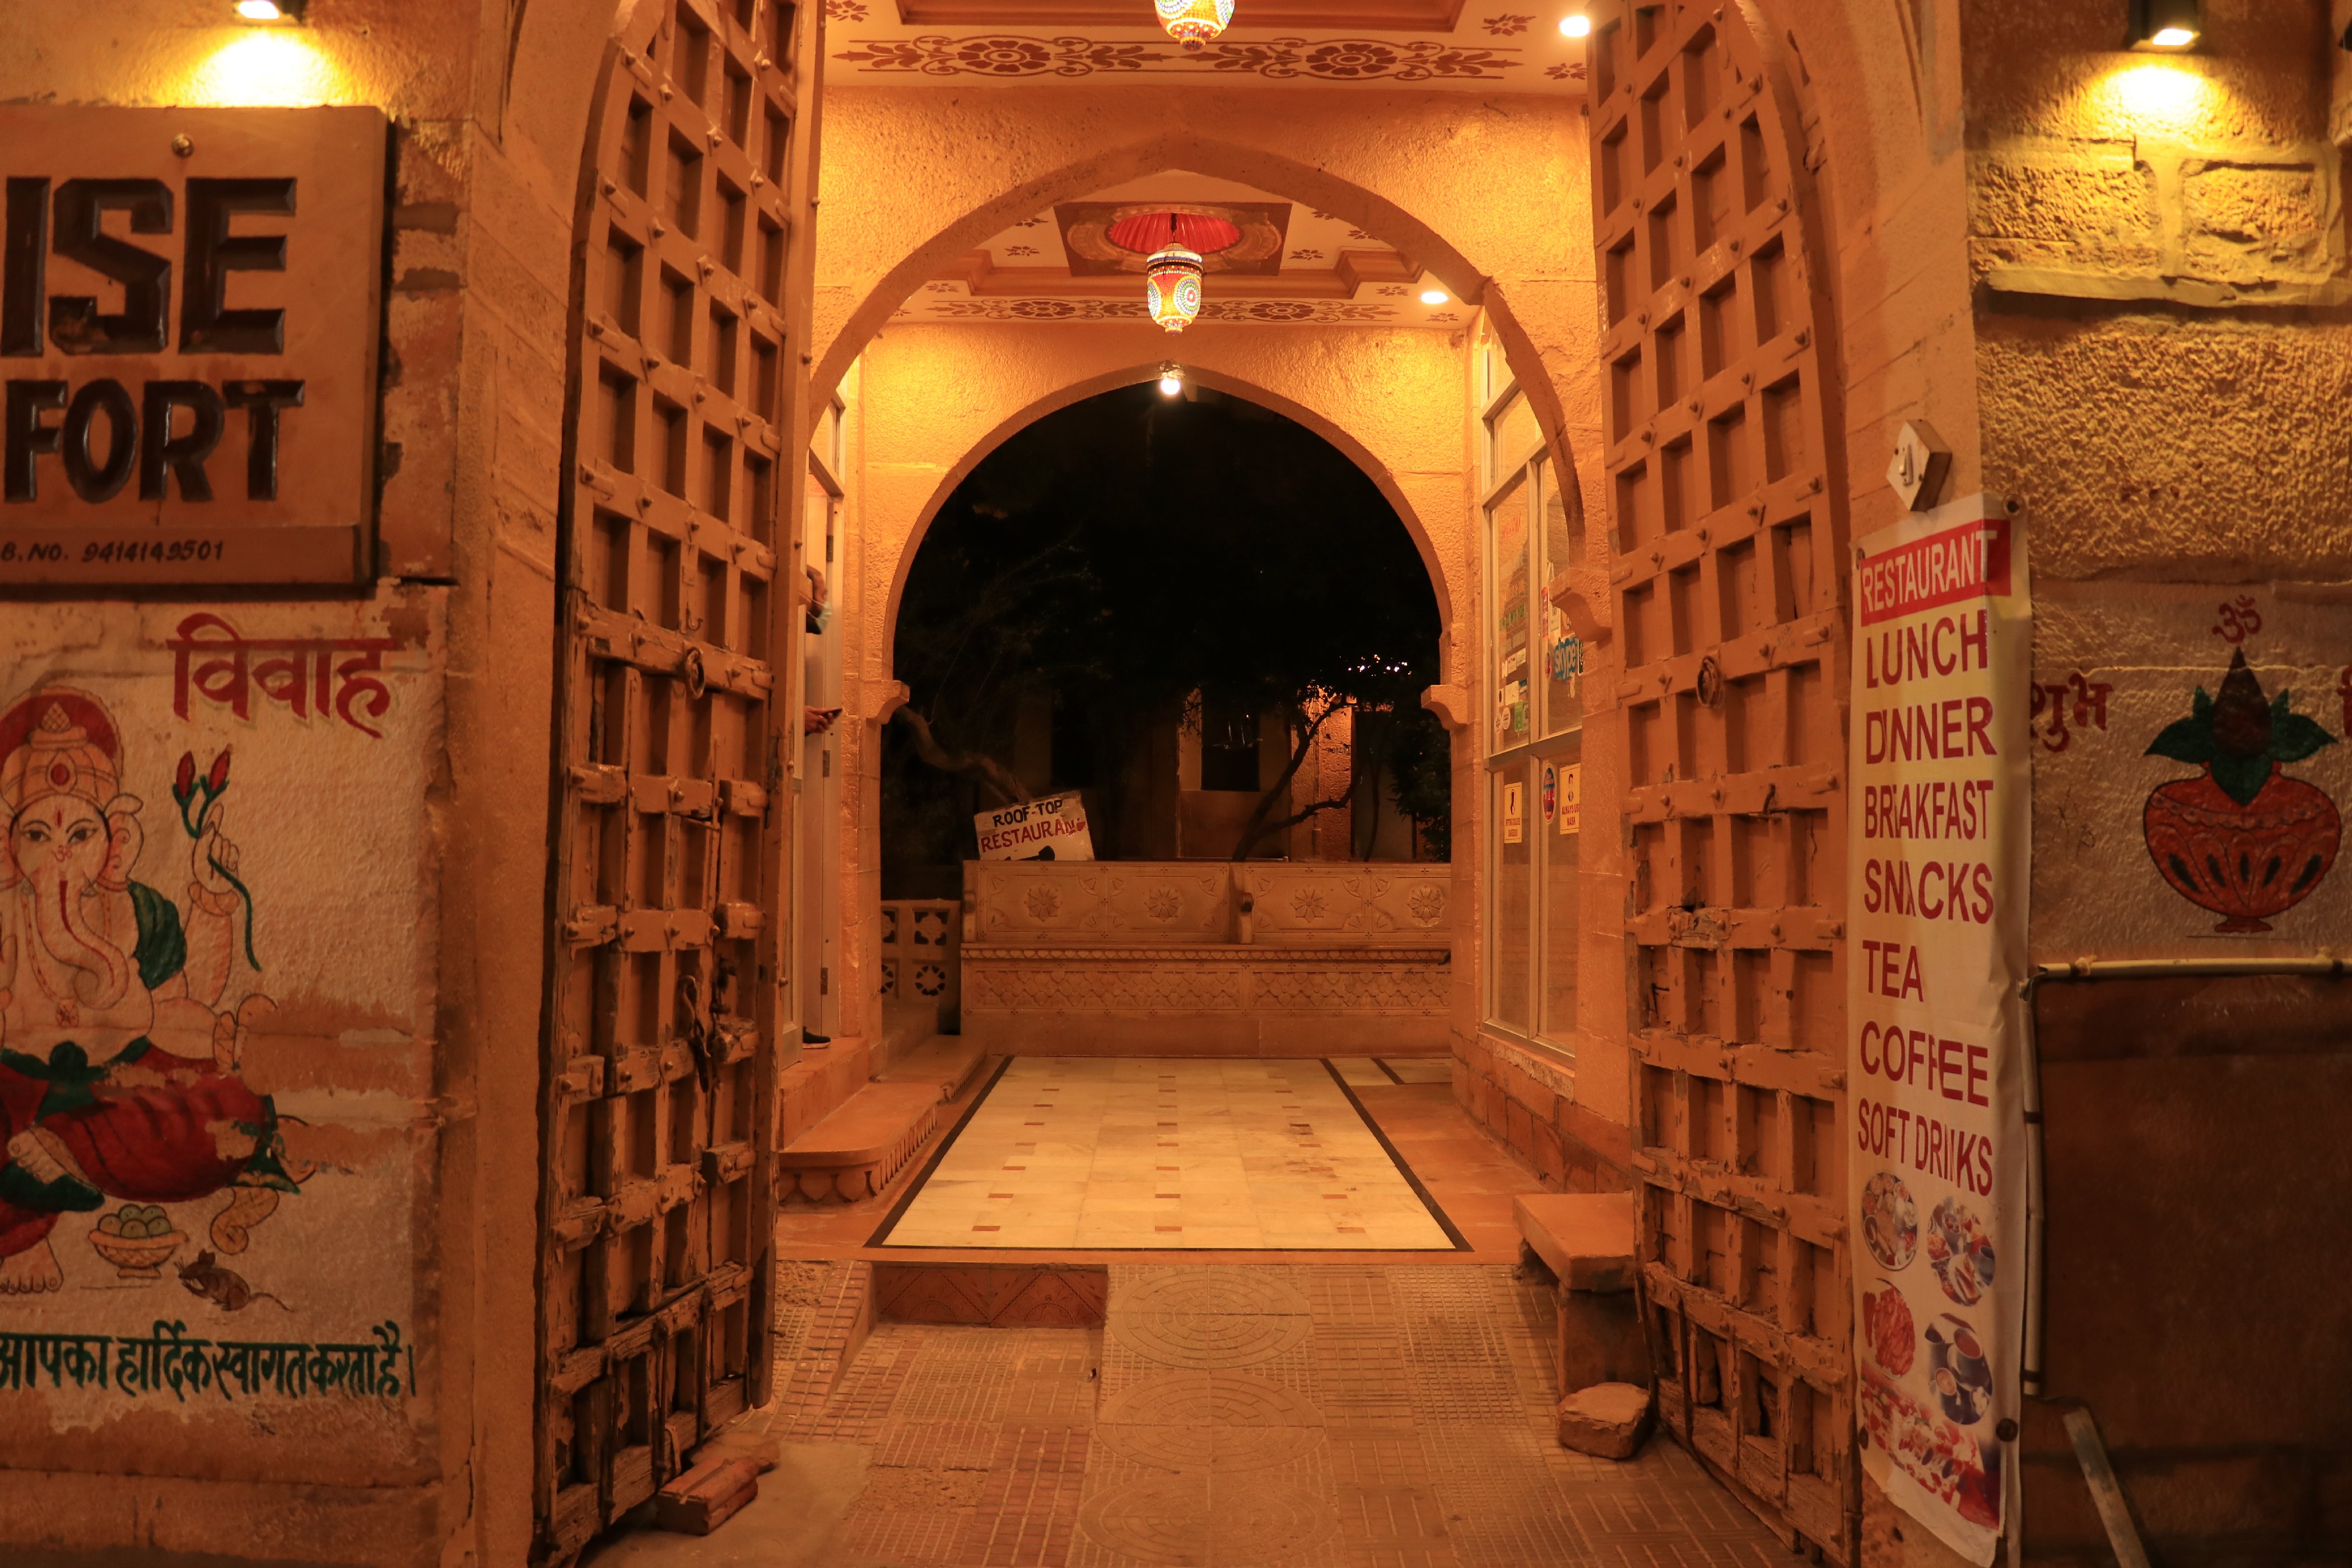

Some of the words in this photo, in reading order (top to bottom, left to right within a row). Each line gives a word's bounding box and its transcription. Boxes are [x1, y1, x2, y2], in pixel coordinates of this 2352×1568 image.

[0, 176, 296, 357] ISE
[4, 378, 305, 504] FORT
[1861, 530, 1997, 613] RESTAURANT
[166, 612, 395, 739] विवाह
[1554, 641, 1576, 679] skype
[1866, 609, 1988, 689] LUNCH
[1866, 696, 1997, 765] DINNER
[1562, 805, 1574, 815] ALWAYS
[1567, 816, 1576, 826] MASK
[1864, 858, 1994, 925] SNACKS
[1862, 939, 1924, 1002] TEA
[1860, 1021, 1989, 1108] COFFEE
[1858, 1098, 1910, 1164] SOFT
[0, 1332, 114, 1390] आपका
[116, 1319, 213, 1403] हार्दिक
[212, 1341, 313, 1401] स्वागत
